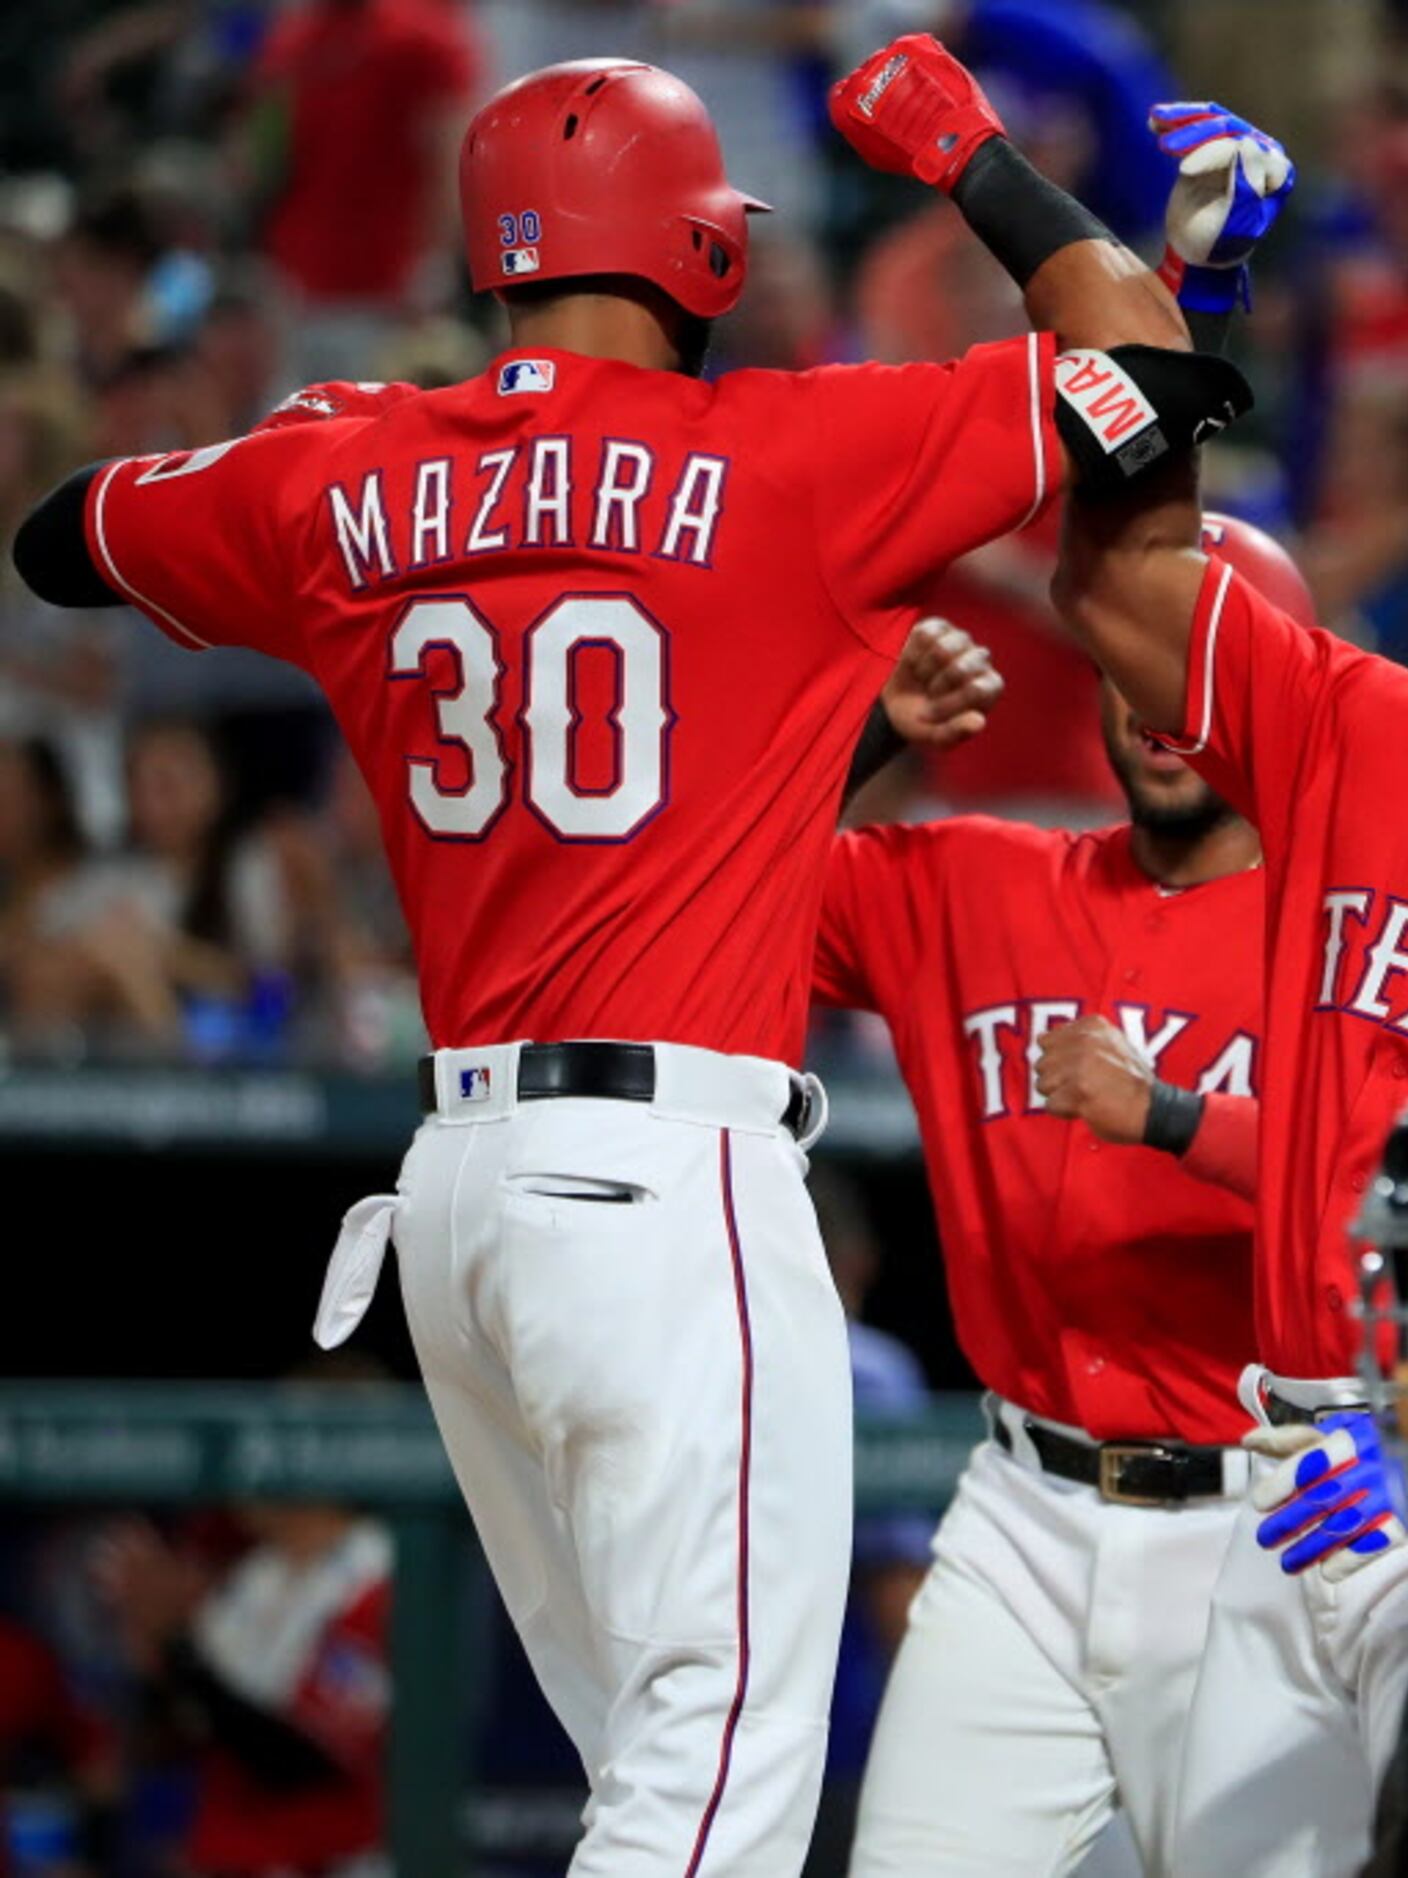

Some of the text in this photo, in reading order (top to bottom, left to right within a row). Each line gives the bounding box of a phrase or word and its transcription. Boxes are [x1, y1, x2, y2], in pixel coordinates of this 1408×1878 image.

[497, 209, 542, 249] 30
[326, 434, 731, 593] MAZARA
[385, 591, 679, 846] 30
